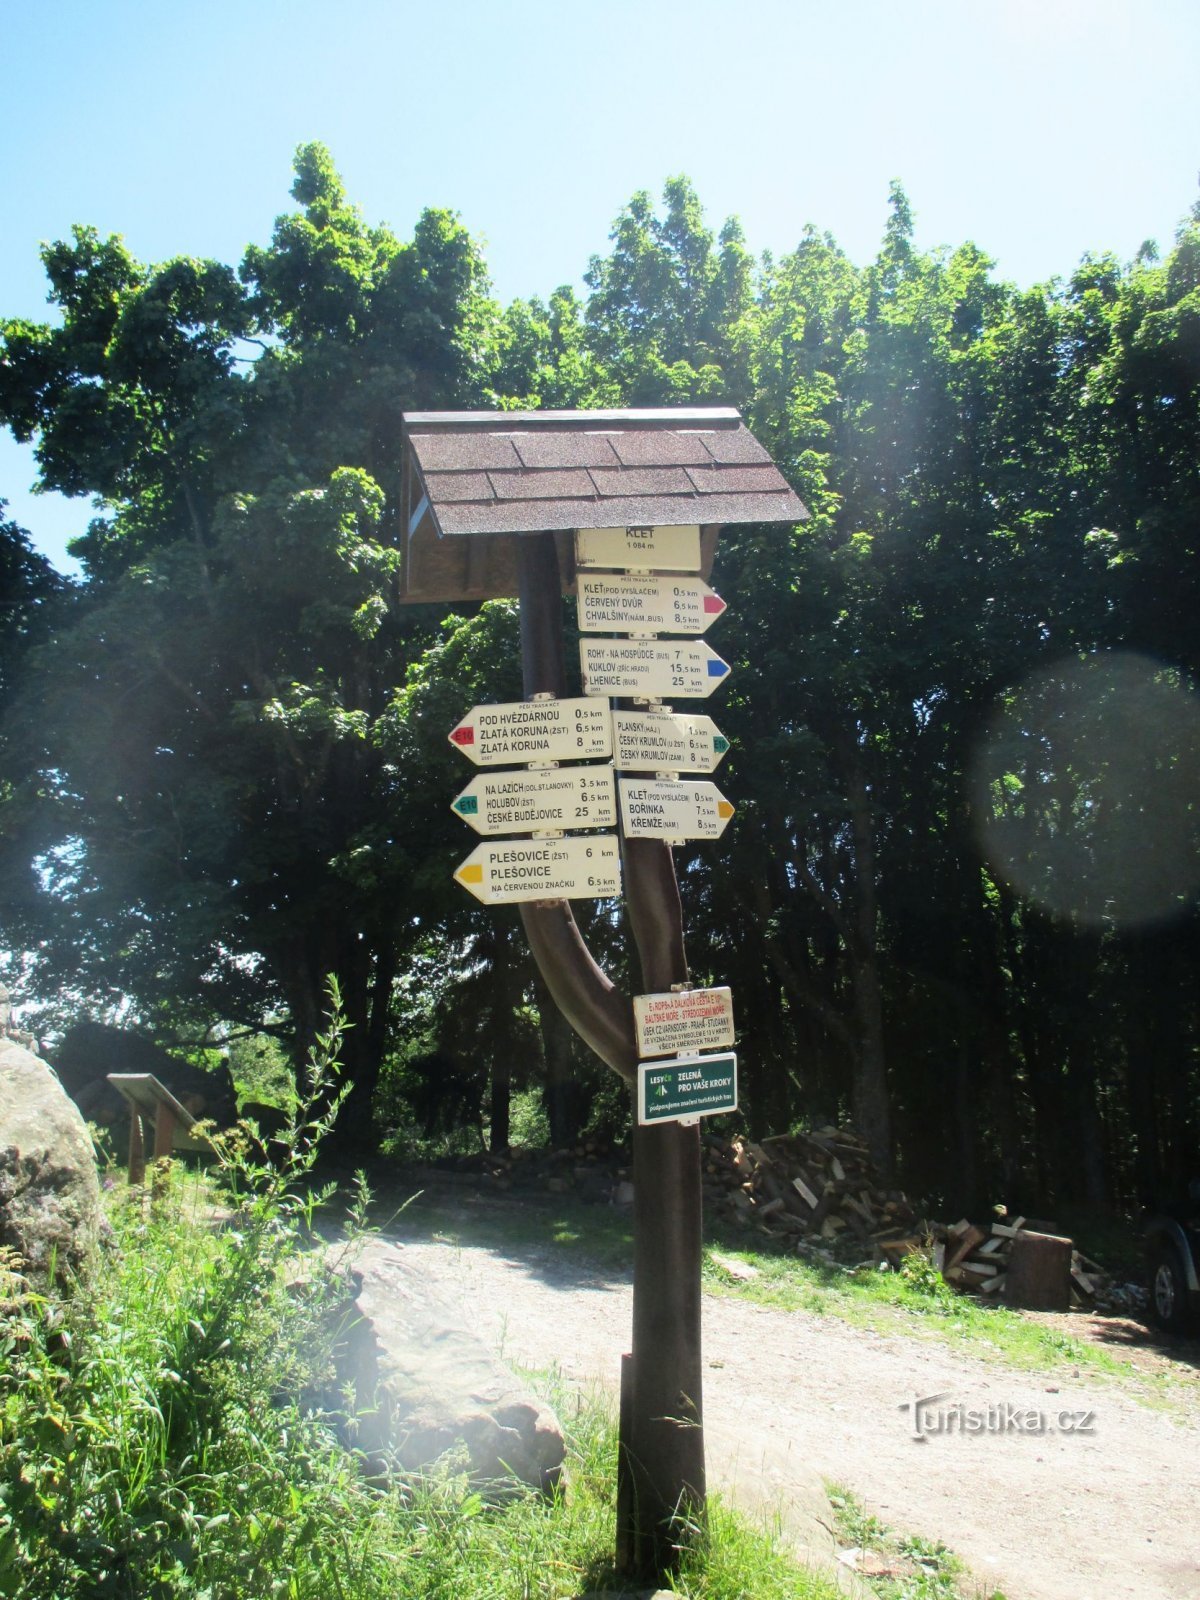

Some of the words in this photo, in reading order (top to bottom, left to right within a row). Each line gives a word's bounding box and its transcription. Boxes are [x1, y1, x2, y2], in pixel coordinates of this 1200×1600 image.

[585, 596, 620, 607] ČERVENÝ
[622, 597, 643, 608] DVŮR
[586, 610, 628, 621] CHVALŠINY
[588, 649, 605, 658] ROHY
[610, 650, 620, 658] NA
[621, 648, 654, 659] HOSPŮDCE
[675, 651, 681, 659] 7
[589, 663, 615, 672] KUKLOV
[590, 676, 621, 685] LHENICE
[672, 677, 684, 686] 25
[480, 716, 498, 725] POD
[501, 711, 560, 724] HVĚZDÁRNOU
[481, 727, 508, 739] ZLATÁ
[511, 726, 548, 737] KORUNA
[481, 741, 509, 754] ZLATÁ
[512, 740, 550, 751] KORUNA
[577, 737, 583, 747] 8
[619, 734, 638, 745] ČESKÝ
[640, 737, 666, 747] KRUMLOV
[621, 748, 639, 759] ČESKÝ
[641, 751, 668, 760] KRUMLOV
[691, 753, 695, 762] 8
[486, 785, 496, 795] NA
[498, 781, 524, 794] LAZÍCH
[487, 798, 520, 809] HOLUBOV
[630, 803, 664, 814] BOŘINKA
[488, 810, 512, 823] ČESKÉ
[515, 809, 562, 821] BUDĚJOVICE
[576, 807, 589, 817] 25
[631, 816, 662, 828] KŘEMŽE
[490, 850, 550, 863] PLEŠOVICE
[552, 852, 569, 861] (ŽST)
[586, 848, 592, 858] 6
[491, 866, 551, 879] PLEŠOVICE
[504, 883, 544, 891] ČERVENOU
[546, 880, 575, 889] ZNAČKU
[678, 1032, 702, 1040] SYMBOLEM
[659, 1042, 675, 1050] VŠECH
[678, 1069, 702, 1081] ZELENÁ
[678, 1084, 692, 1092] PRO
[693, 1079, 708, 1090] VAŠE
[710, 1078, 731, 1088] KROKY
